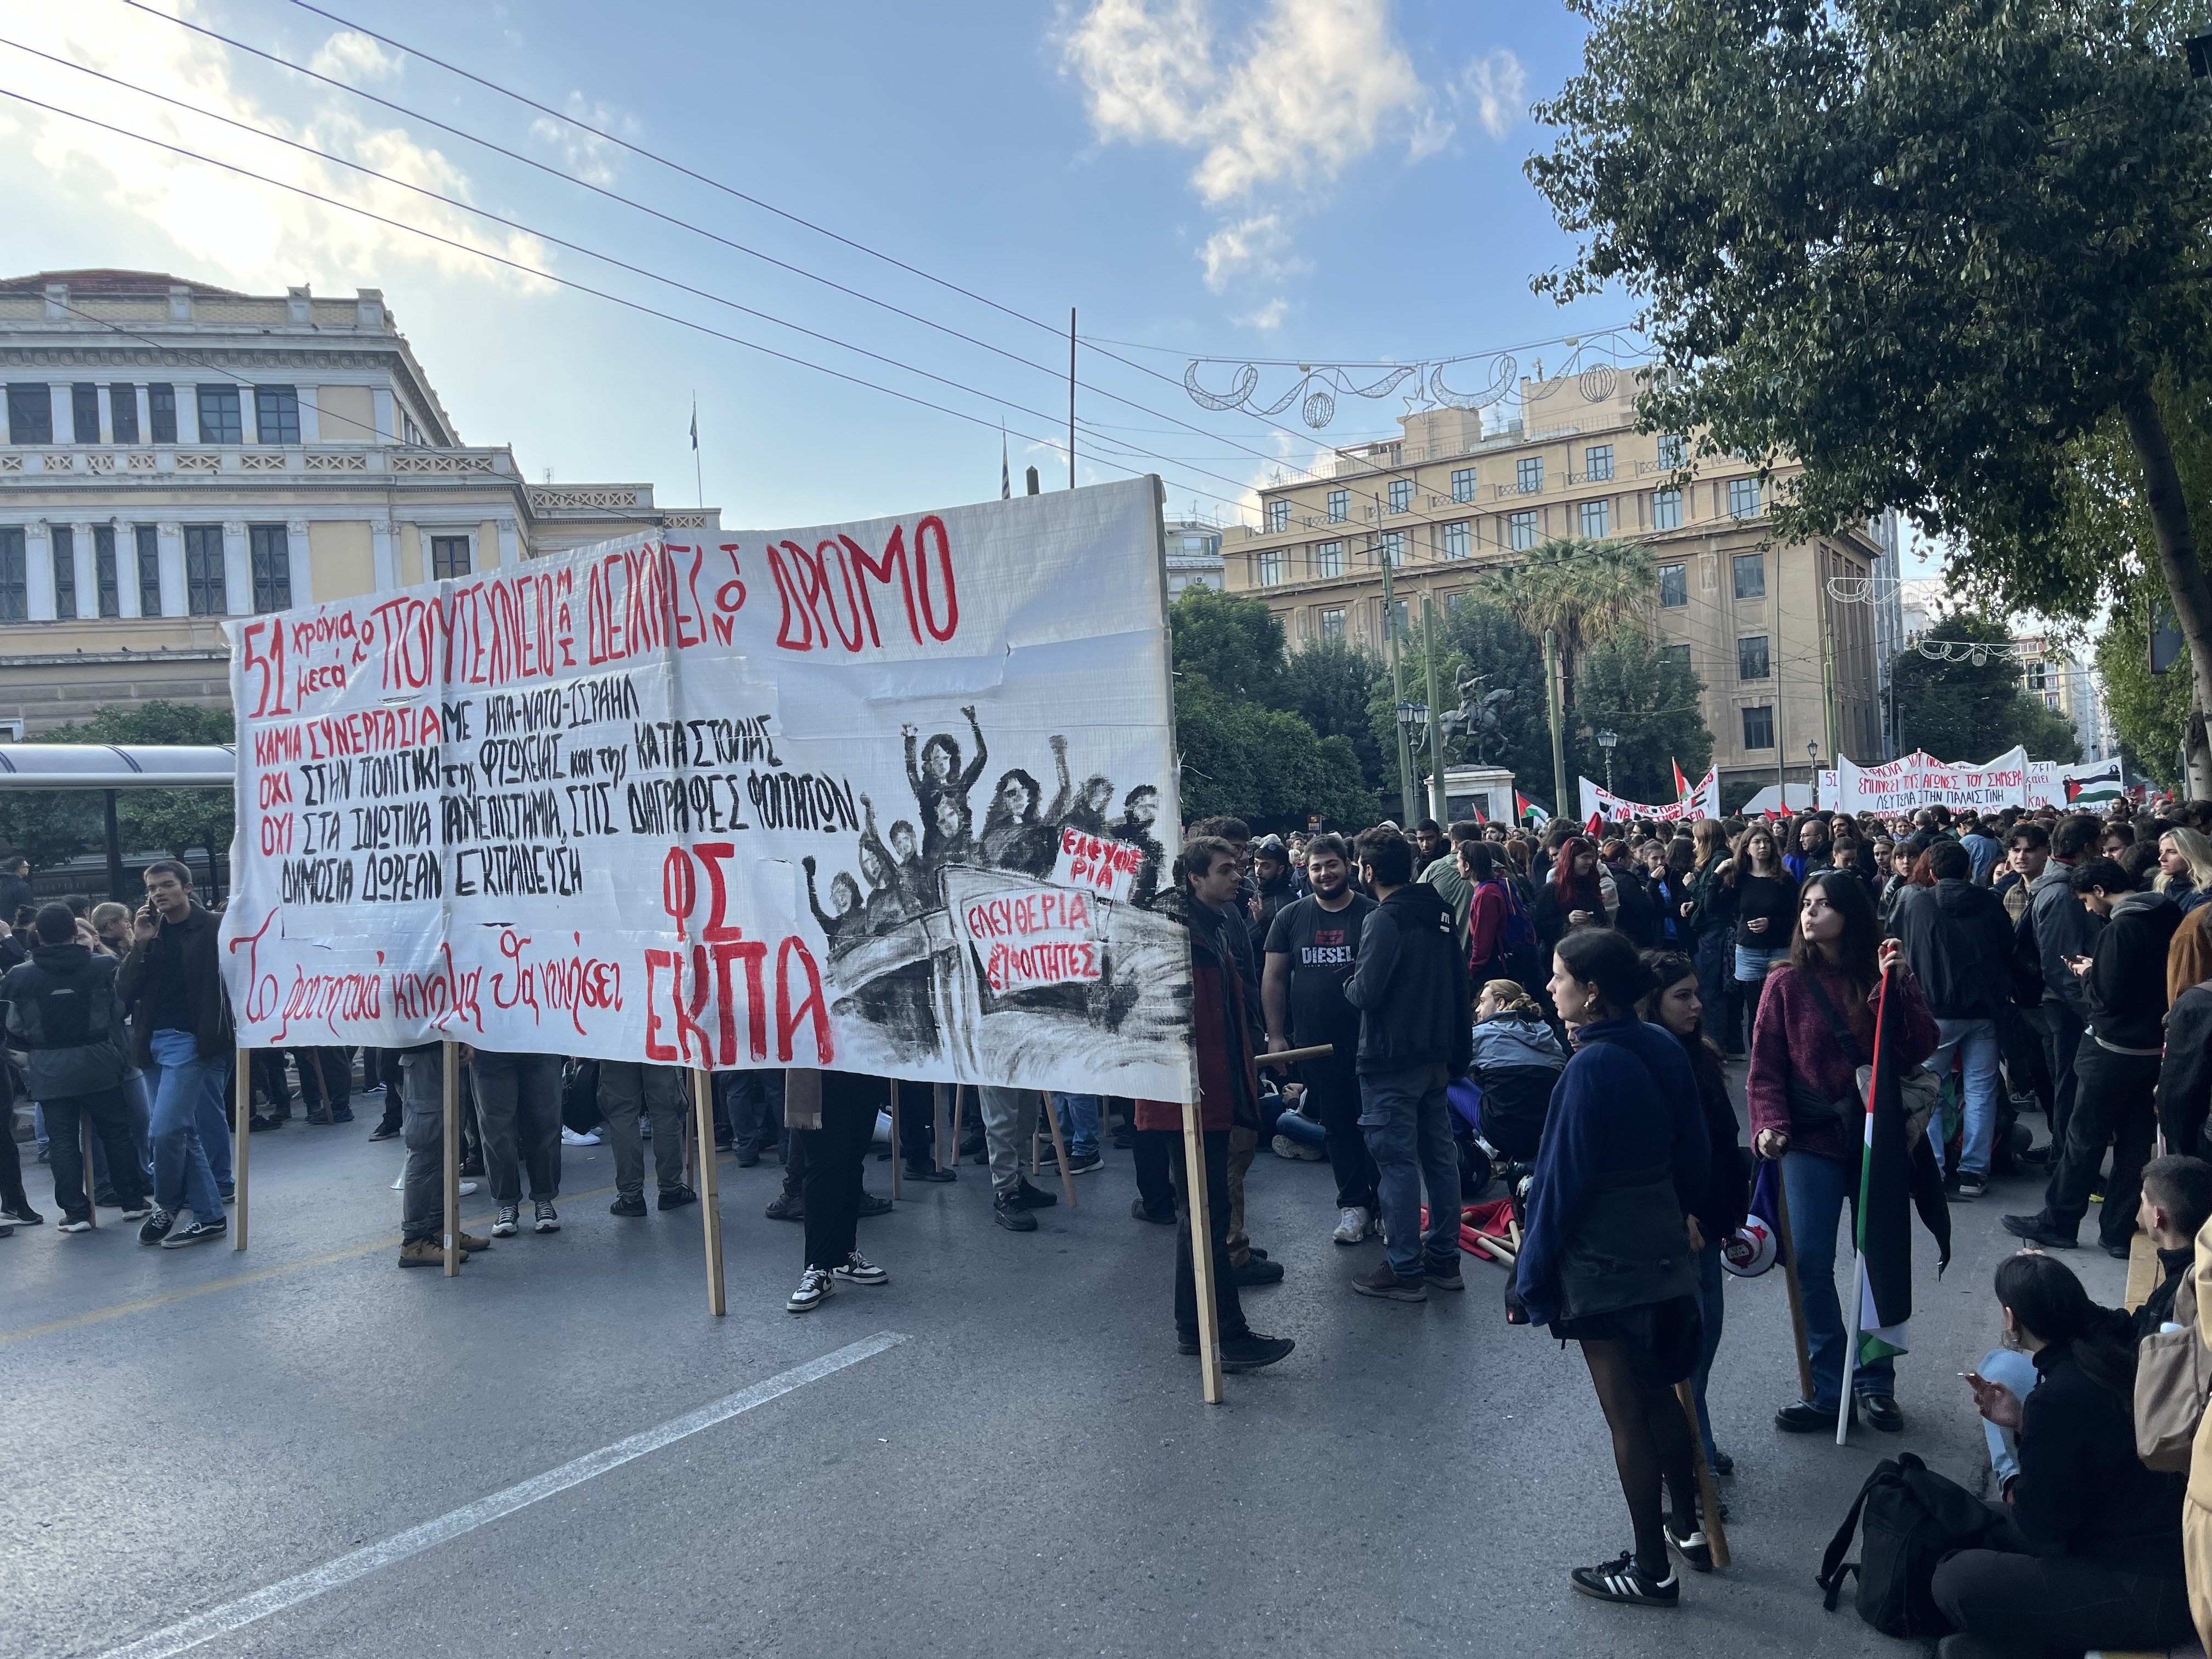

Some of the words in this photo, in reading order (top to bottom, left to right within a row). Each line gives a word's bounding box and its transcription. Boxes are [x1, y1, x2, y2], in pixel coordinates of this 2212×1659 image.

[712, 544, 746, 647] ΤΟΝ
[768, 515, 958, 653] ΔΡΟΜΟ
[291, 605, 358, 658] χρόνια
[244, 618, 292, 718] 51
[297, 647, 347, 712] μετά
[255, 724, 302, 768] ΚΑΜΙΑ
[307, 705, 441, 760] ΣΥΝΕΡΓΑΣΙΑ
[441, 699, 473, 743] ΜΕ
[259, 770, 293, 810] ΟΧΙ
[300, 758, 352, 806] ΣΤΗΝ
[479, 732, 567, 788] ΦΤΩΧΕΙΑΣ
[570, 747, 595, 779] και
[1826, 772, 1838, 787] 51
[1869, 763, 1903, 778] ΦΛΟΓΑ
[1903, 774, 1919, 791] ΤΟΥΣ
[1923, 774, 1961, 790] ΑΓΩΝΕΣ
[1965, 774, 1983, 787] ΤΟΥ
[1987, 770, 2023, 787] ΣΗΜΕΡΑ
[1946, 789, 2004, 805] ΠΑΛΑΙΣΤΙΝΗ
[302, 811, 341, 855] ΣΤΑ
[349, 800, 432, 851] ΙΔΙΩΤΙΚΑ
[566, 781, 620, 837] ΣΤΙΣ
[627, 774, 749, 837] ΔΙΑΓΡΑΦΕΣ
[747, 768, 860, 833] ΦΟΙΤΗΤΩΝ
[283, 857, 354, 905] ΔΗΜΟΣΙΑ
[362, 850, 442, 902] ΔΩΡΕΑΝ
[455, 842, 583, 897] ΕΚΠΑΙΔΕΥΣΗ
[663, 842, 742, 943] ΦΣ
[968, 889, 1091, 939] ΕΛΕΥΘΕΡΙΑ
[230, 906, 278, 1024] Το
[1010, 941, 1101, 982] ΦΟΙΤΗΤΕΣ
[1301, 945, 1355, 964] DIESEL
[645, 935, 834, 1071] ΕΚΠΑ
